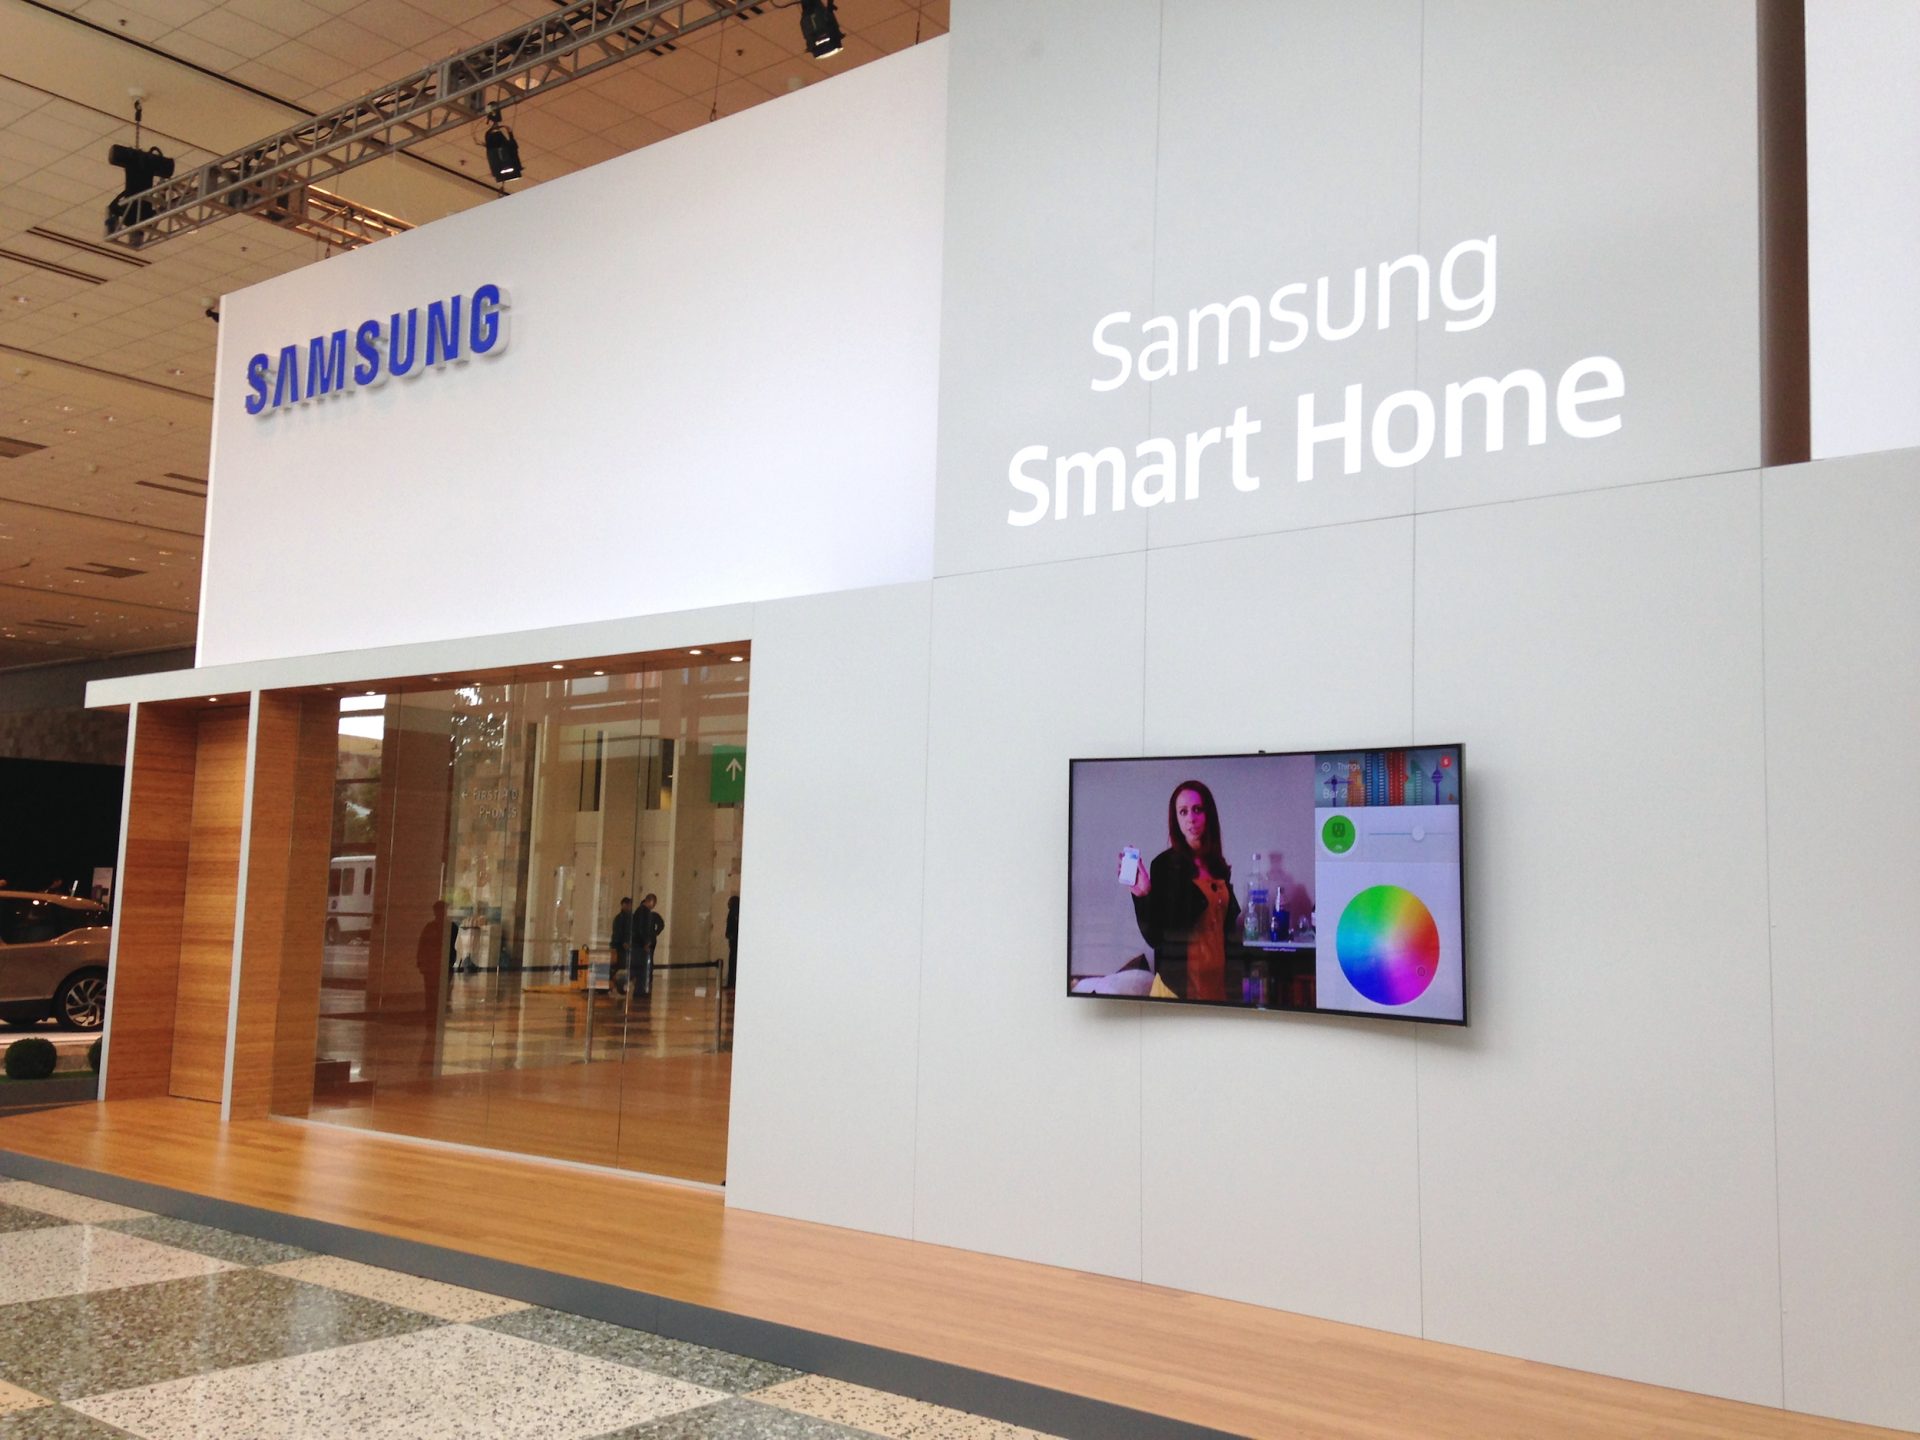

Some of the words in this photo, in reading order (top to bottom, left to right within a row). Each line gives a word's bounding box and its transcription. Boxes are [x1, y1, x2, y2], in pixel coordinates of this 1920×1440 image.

[246, 284, 500, 415] SAMSUNG
[1090, 235, 1497, 392] Samsung
[1007, 406, 1262, 527] Smart
[1297, 355, 1626, 483] Home
[480, 807, 517, 818] PHONS
[1337, 762, 1361, 771] Things
